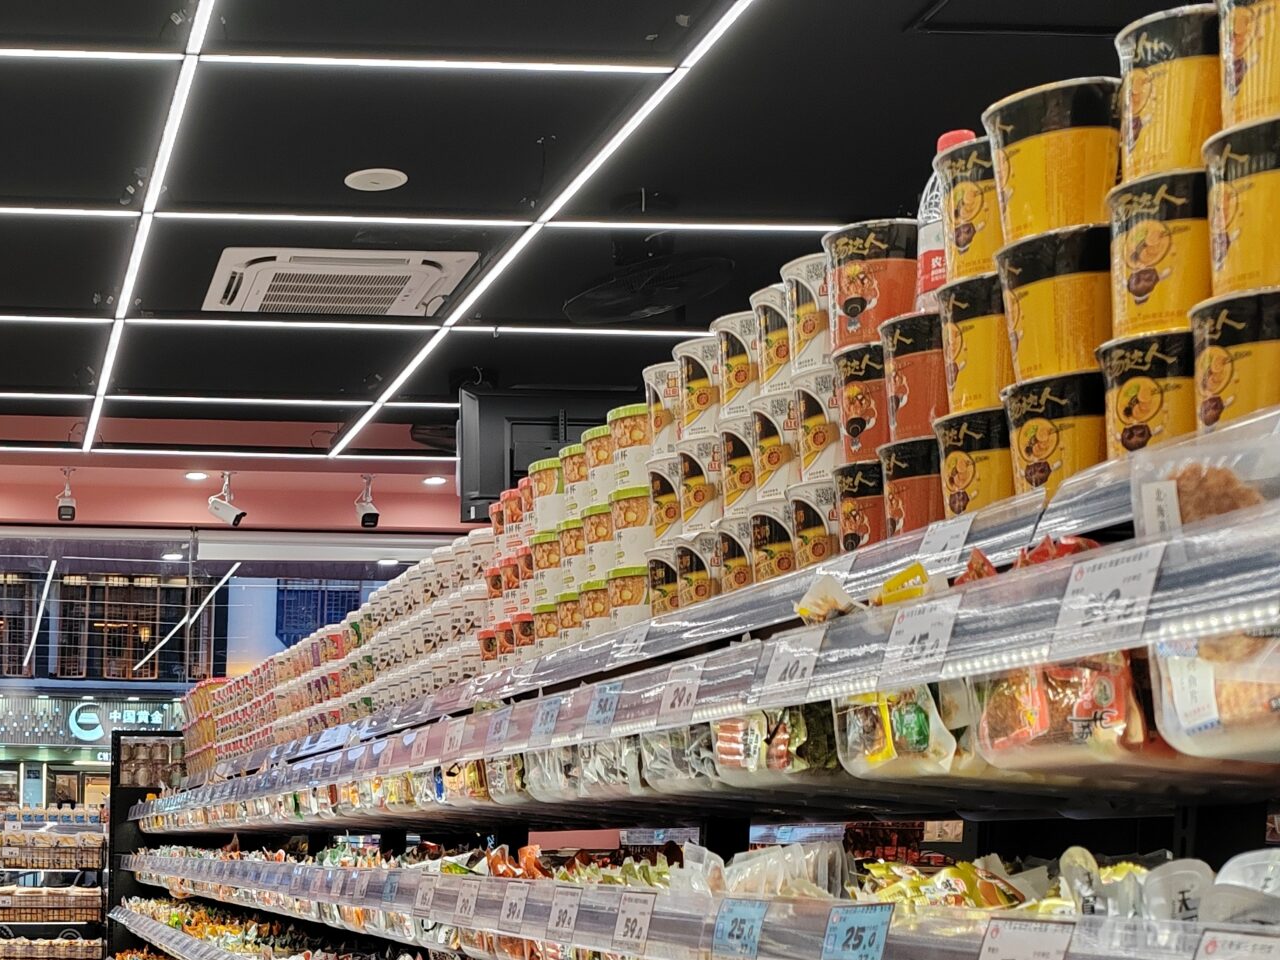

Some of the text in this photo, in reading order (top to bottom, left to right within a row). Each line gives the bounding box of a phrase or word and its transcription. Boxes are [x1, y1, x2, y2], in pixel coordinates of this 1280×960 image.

[109, 710, 164, 724] 中国黄金
[842, 925, 877, 951] 25.0
